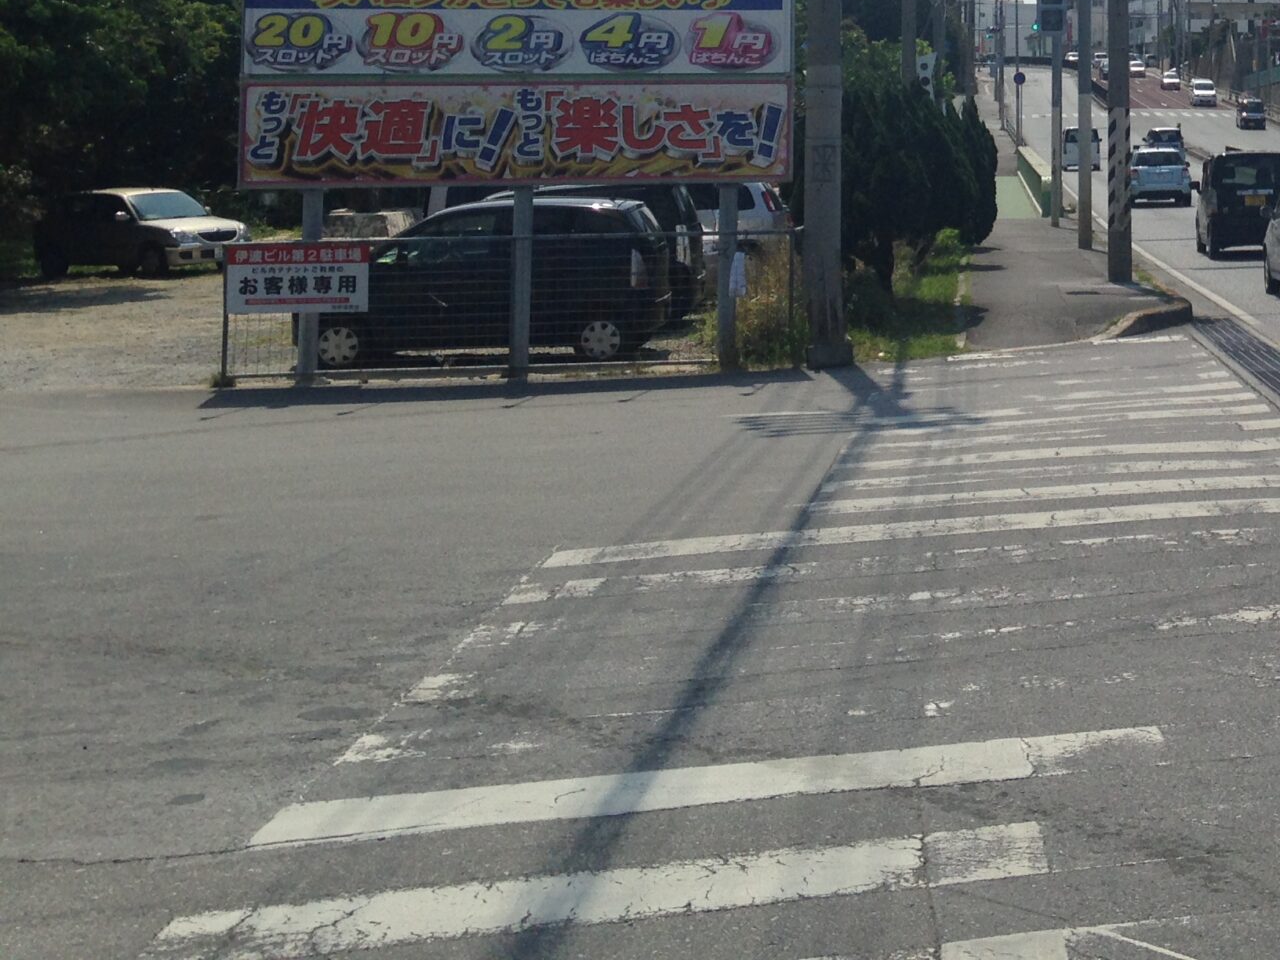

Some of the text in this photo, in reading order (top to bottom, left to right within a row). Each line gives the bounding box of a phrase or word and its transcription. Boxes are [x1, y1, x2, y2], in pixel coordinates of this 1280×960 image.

[255, 49, 337, 65] スロット
[365, 49, 449, 65] スロット
[484, 51, 556, 65] スロット
[238, 275, 357, 296] お客様専用
